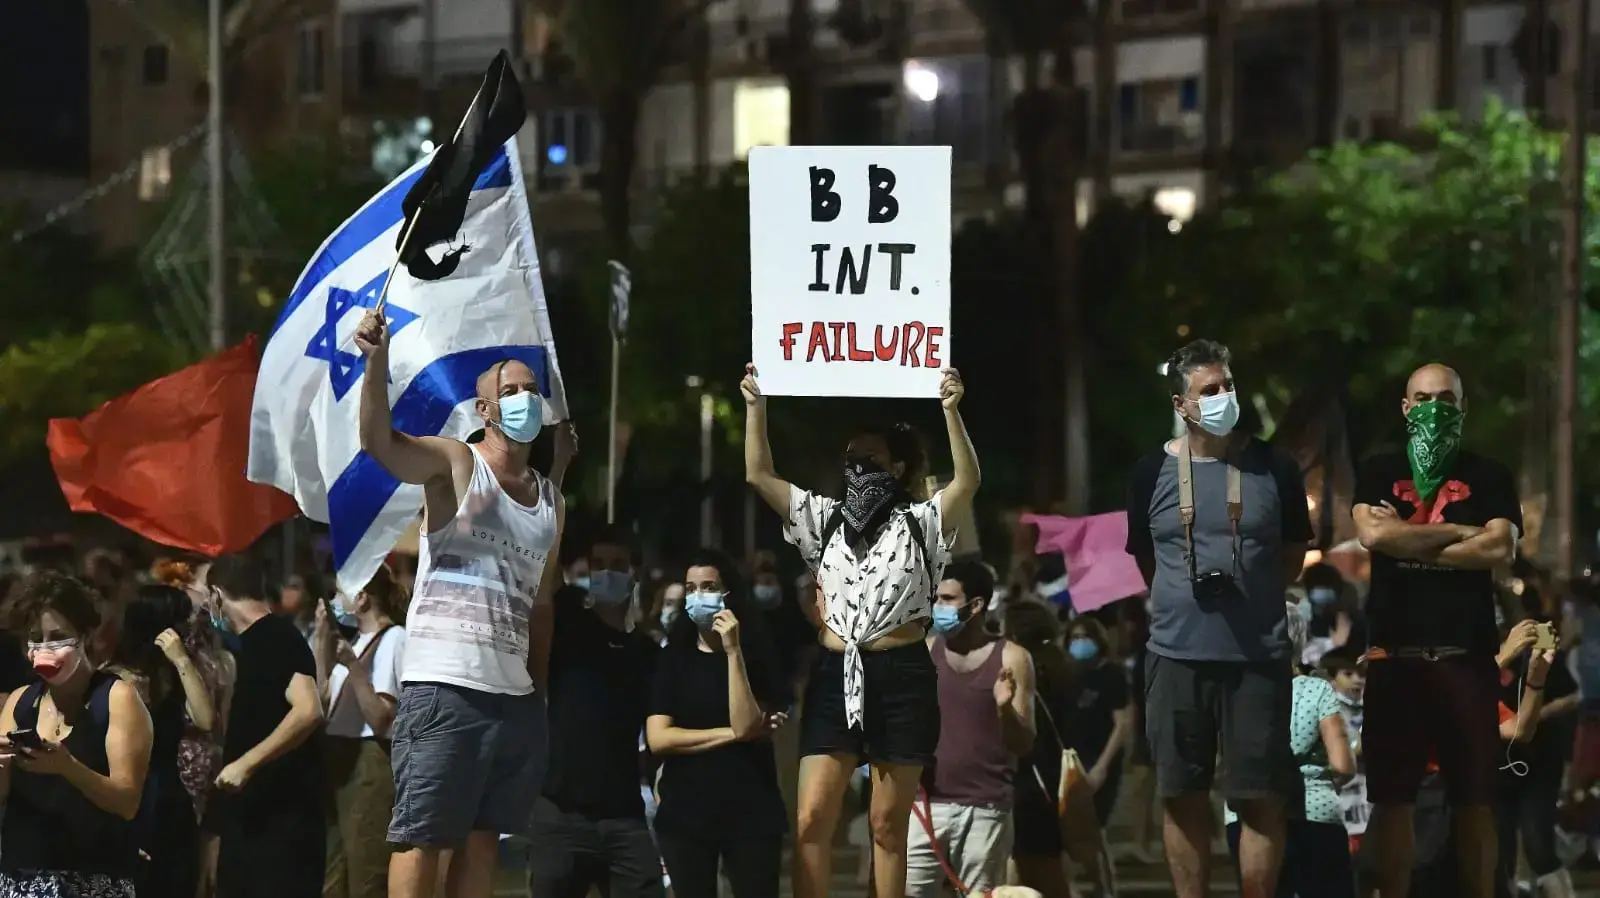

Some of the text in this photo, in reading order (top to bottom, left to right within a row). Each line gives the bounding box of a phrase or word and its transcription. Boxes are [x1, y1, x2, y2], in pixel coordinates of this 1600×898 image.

[808, 164, 899, 223] B B
[808, 243, 920, 295] INT.
[779, 321, 944, 368] FAILURE
[472, 529, 496, 541] LOS
